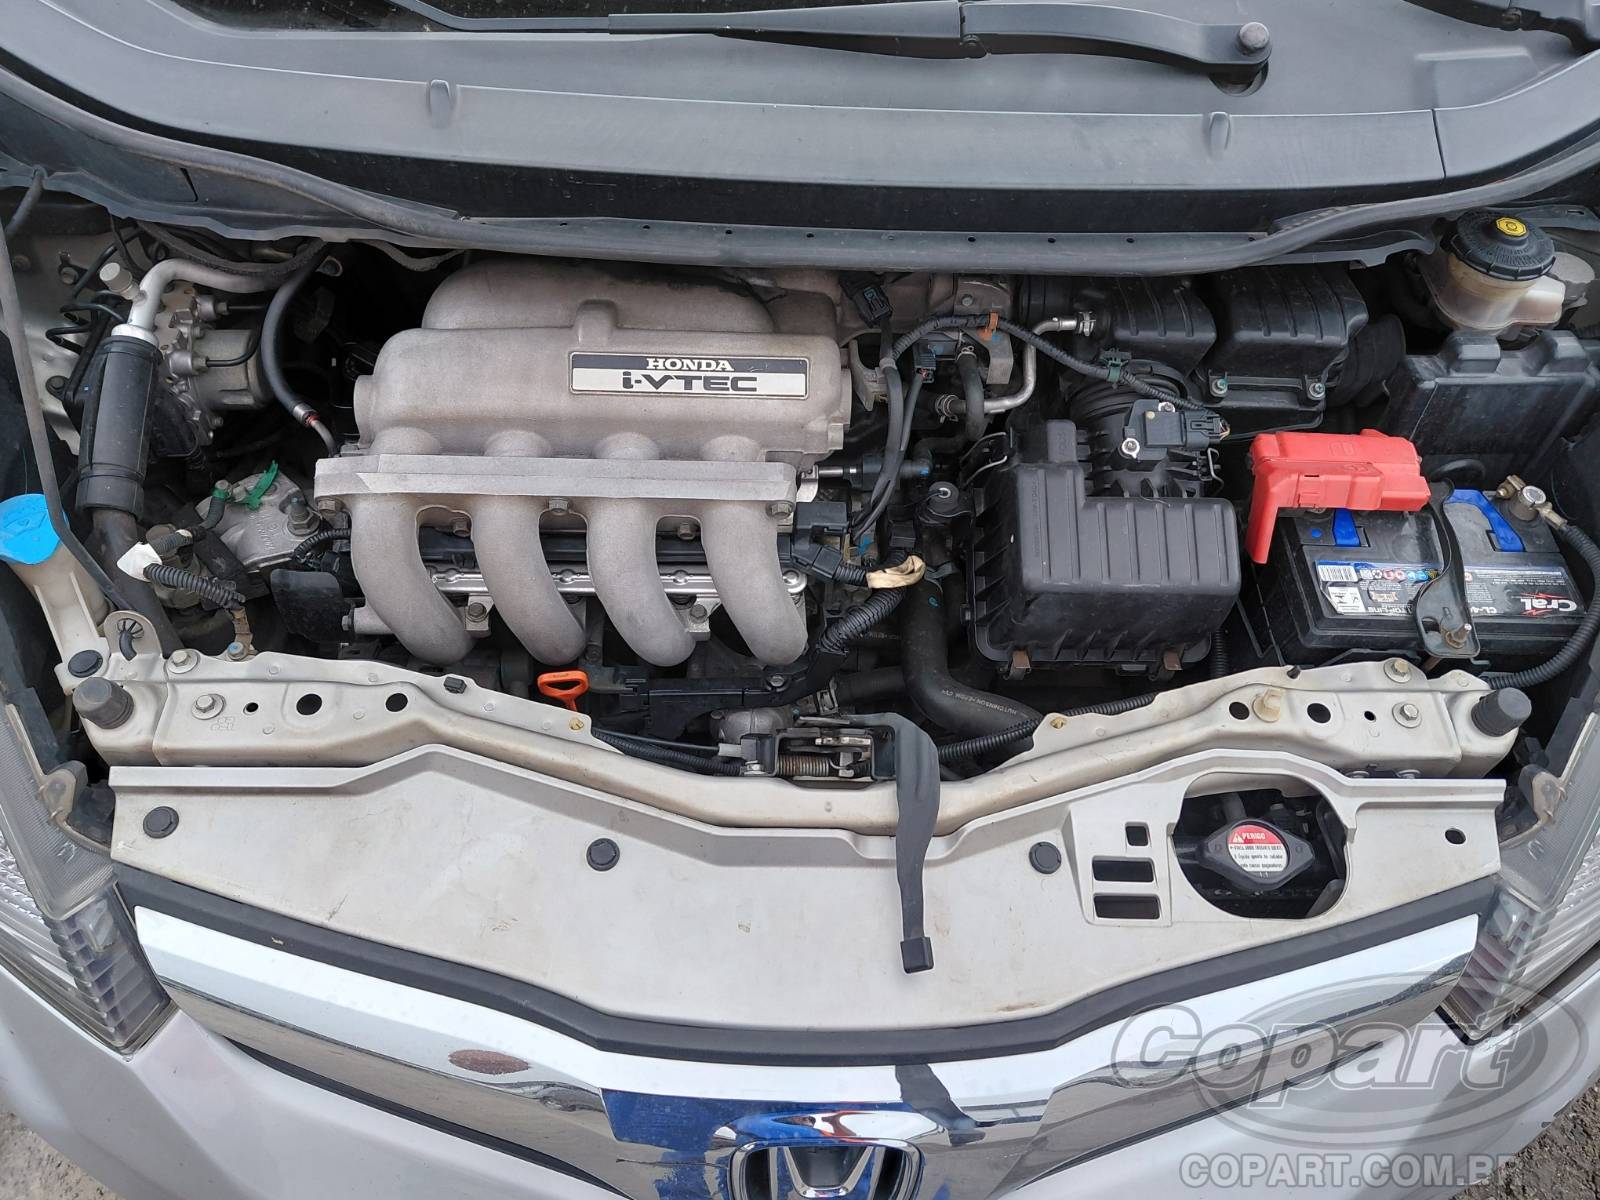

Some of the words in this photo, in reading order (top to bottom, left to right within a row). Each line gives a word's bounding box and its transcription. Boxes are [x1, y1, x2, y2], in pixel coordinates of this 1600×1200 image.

[646, 357, 735, 372] HONDA
[621, 371, 758, 392] i-VTEC
[1241, 832, 1266, 840] PERIGO
